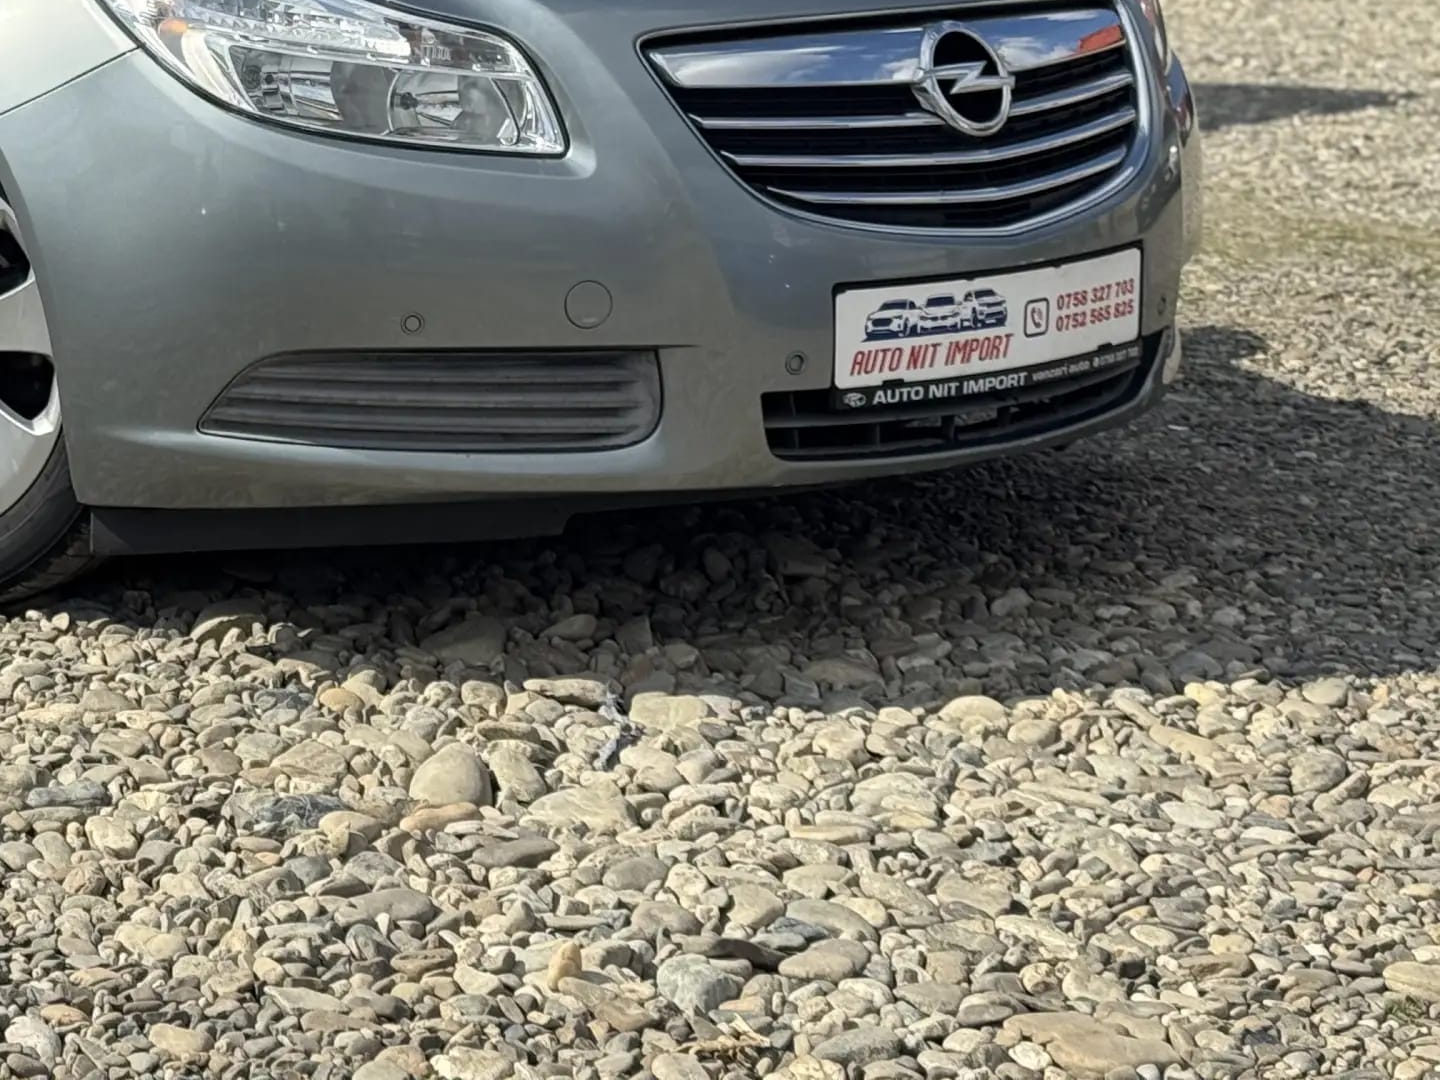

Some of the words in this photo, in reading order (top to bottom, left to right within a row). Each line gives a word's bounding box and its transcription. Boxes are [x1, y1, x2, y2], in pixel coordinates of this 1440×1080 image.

[1056, 290, 1089, 311] 0758
[1091, 283, 1113, 304] 327
[1115, 278, 1135, 298] 703
[1055, 311, 1088, 332] 0752
[850, 345, 905, 377] AUTO
[907, 340, 941, 372] NIT
[945, 332, 1014, 367] IMPORT
[872, 386, 925, 407] AUTO
[928, 381, 960, 400] NIT
[963, 371, 1029, 395] IMPORT
